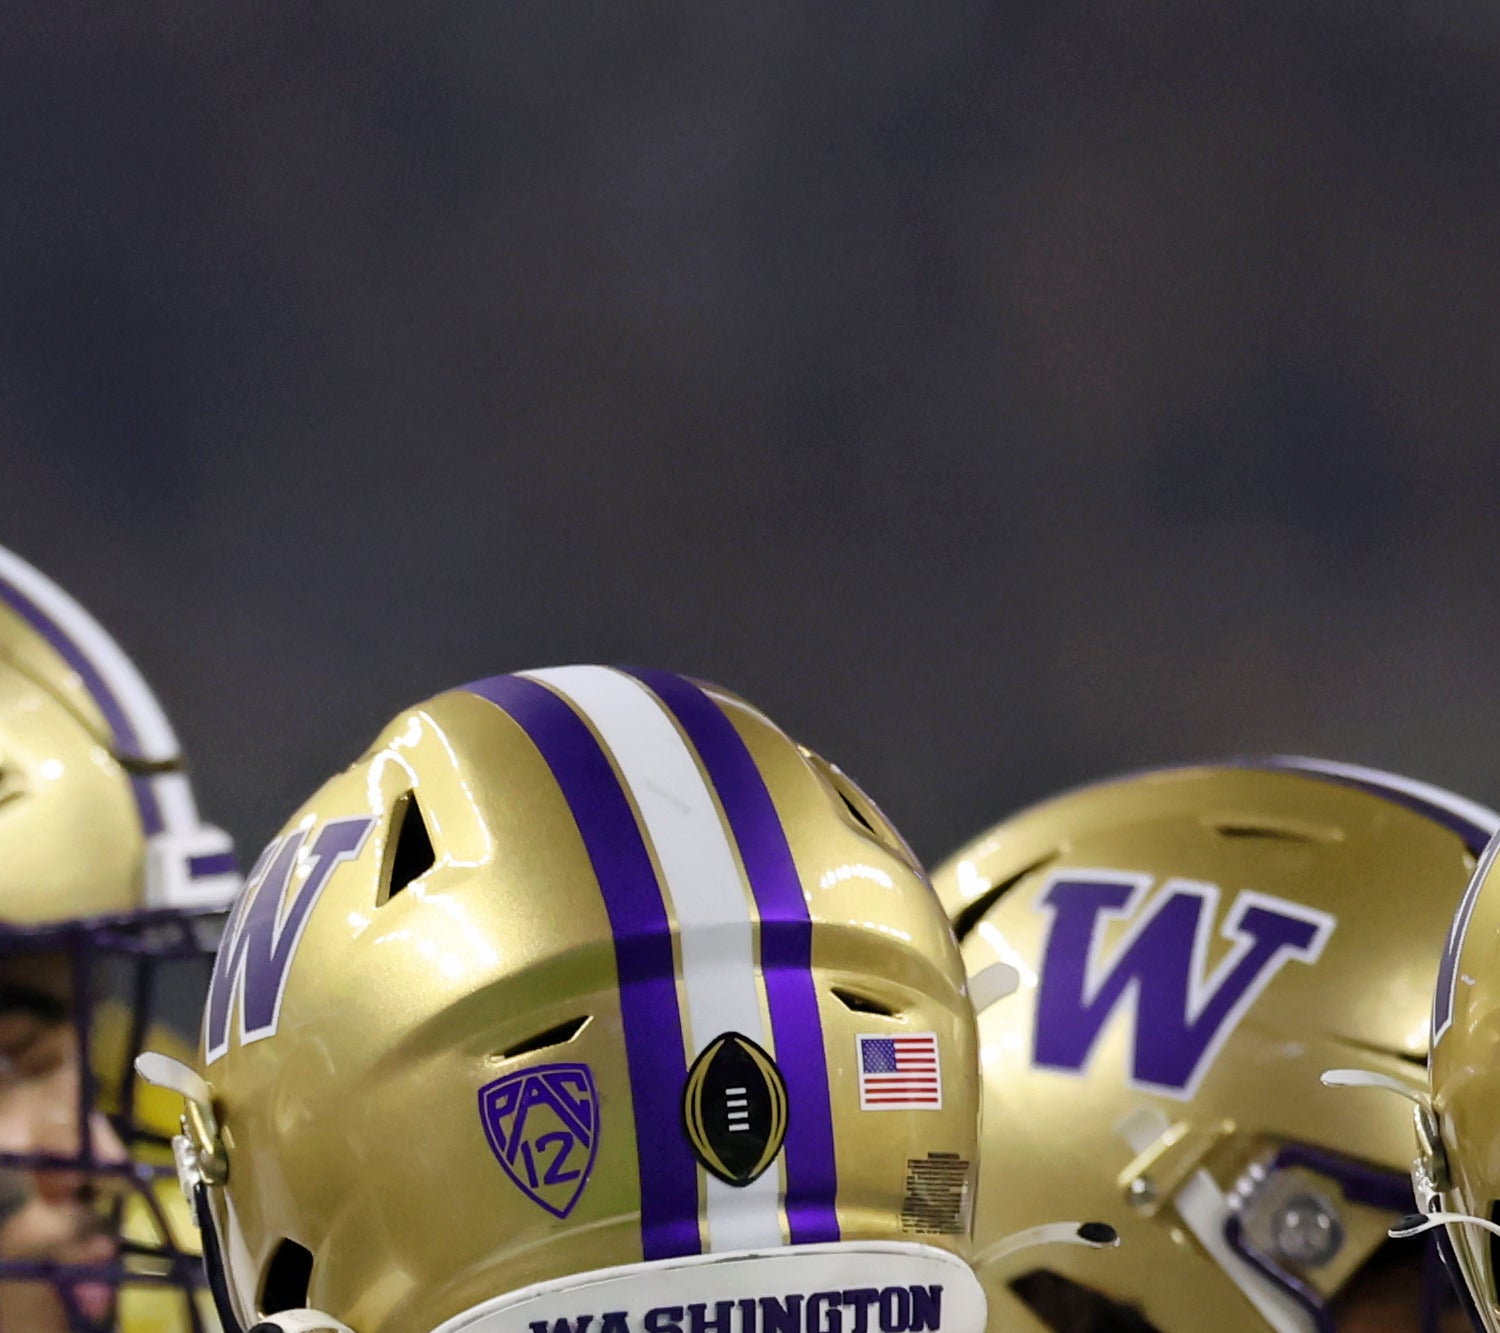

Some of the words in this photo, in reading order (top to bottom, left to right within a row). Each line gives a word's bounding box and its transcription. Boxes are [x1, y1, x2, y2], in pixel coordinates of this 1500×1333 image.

[1031, 868, 1337, 1100] W
[487, 1073, 592, 1167] PAC
[521, 1131, 581, 1189] 12
